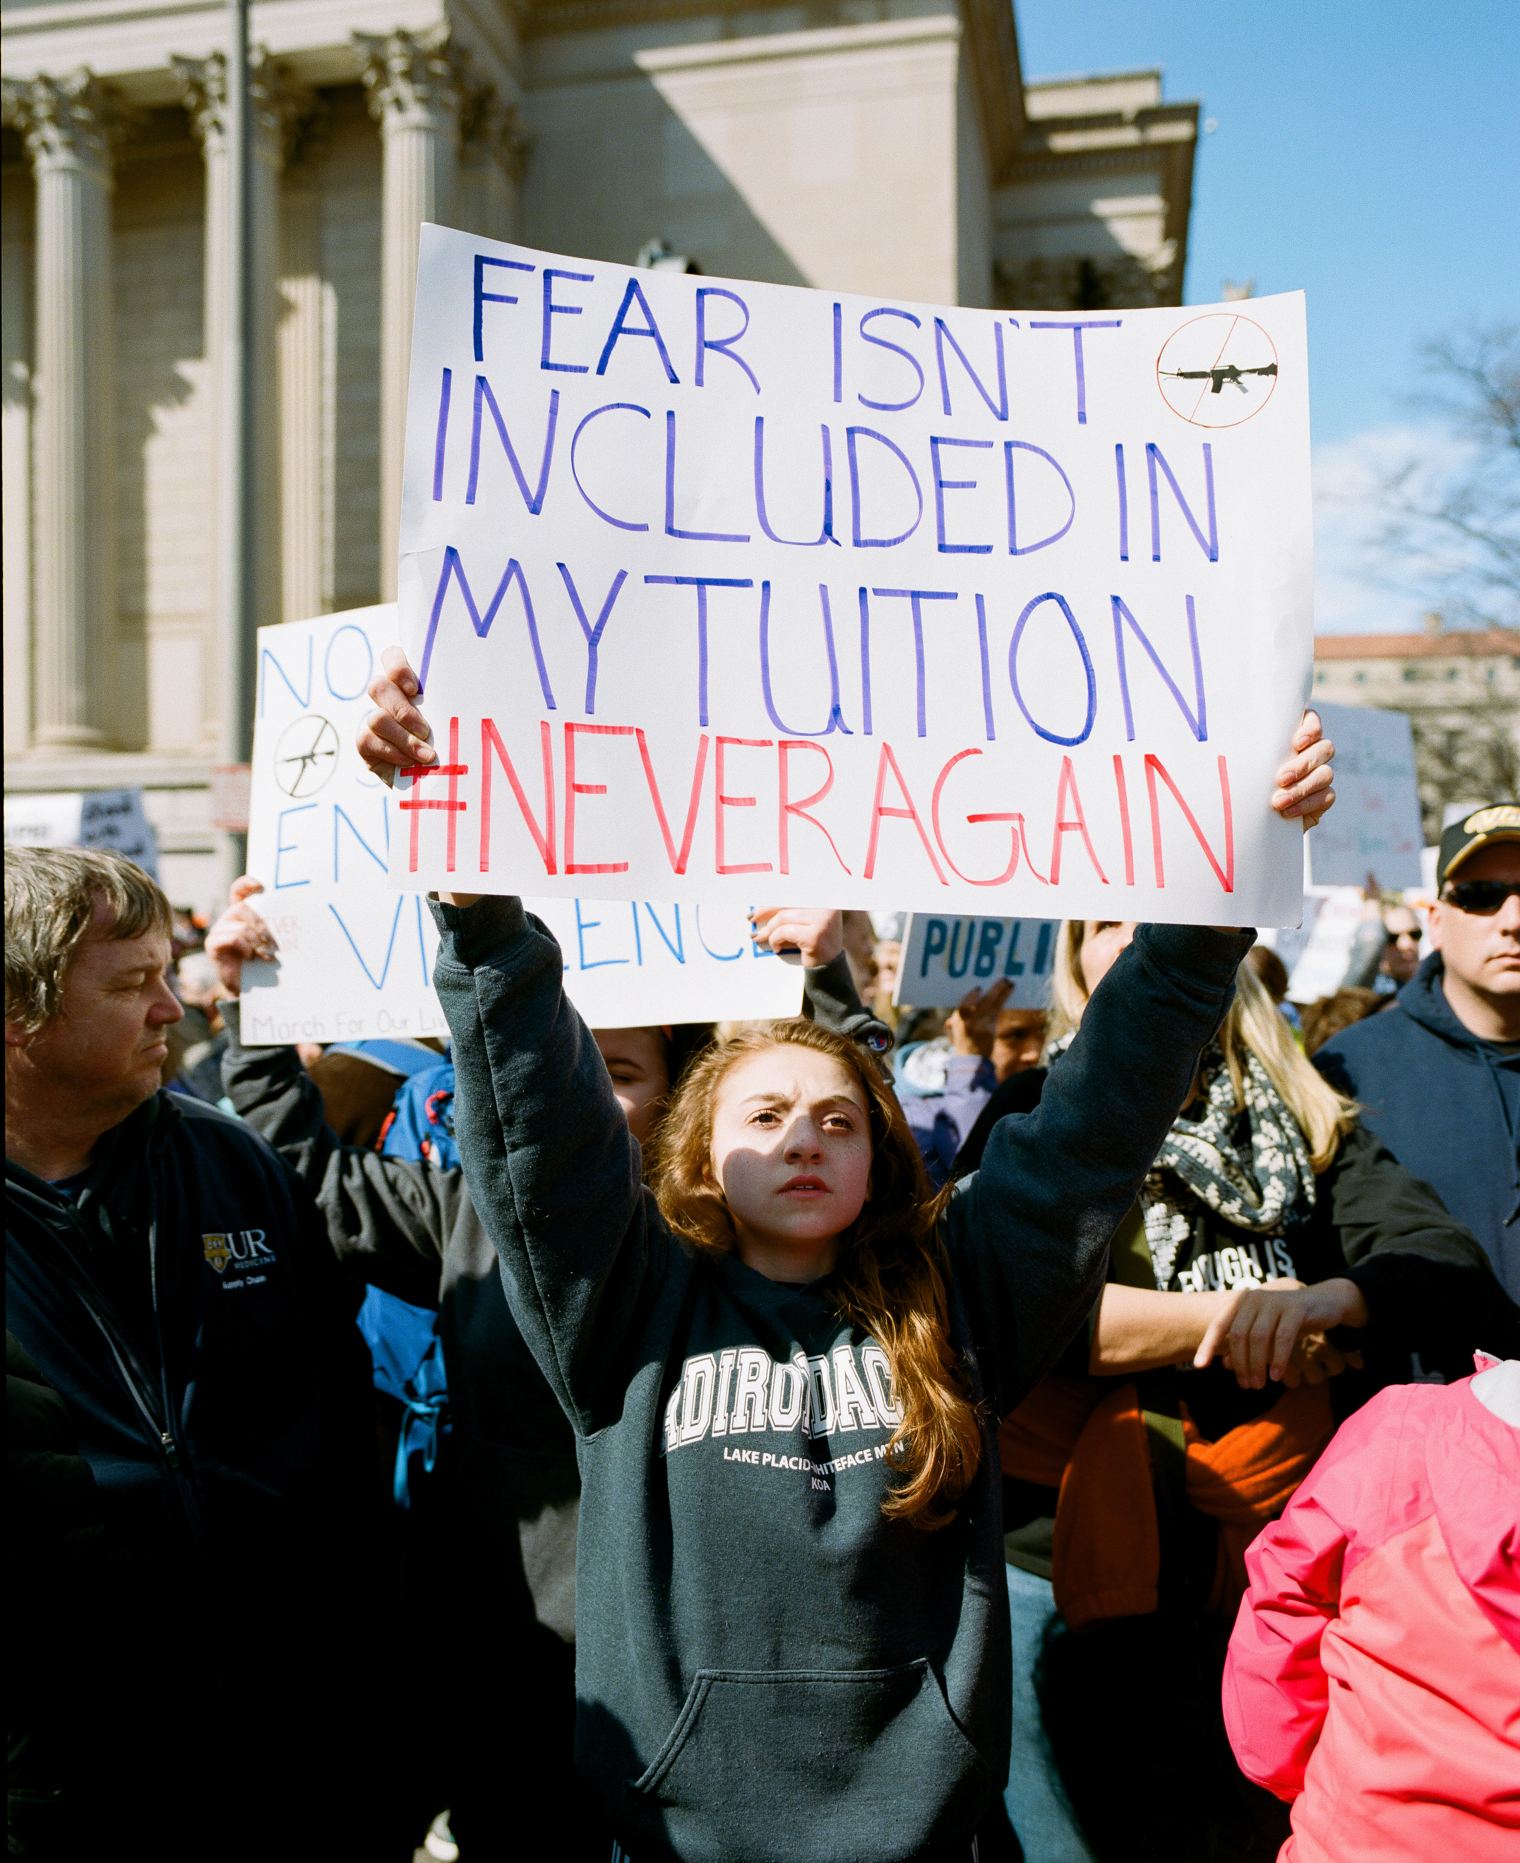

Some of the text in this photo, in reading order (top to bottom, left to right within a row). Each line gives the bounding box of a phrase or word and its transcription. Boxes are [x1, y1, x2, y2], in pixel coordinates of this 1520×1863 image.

[473, 254, 1123, 424] FEAR ISN'T
[433, 368, 1218, 562] INCLUDED IN
[260, 624, 373, 719] NO
[417, 545, 1209, 747] MY TUITION
[274, 795, 389, 890] EN
[920, 918, 1052, 978] PUBLI
[251, 1014, 327, 1042] March
[335, 1011, 366, 1035] For
[376, 1008, 411, 1033] Our
[226, 1228, 273, 1260] UR
[723, 1446, 760, 1465] LAKE
[811, 1476, 832, 1492] KOA
